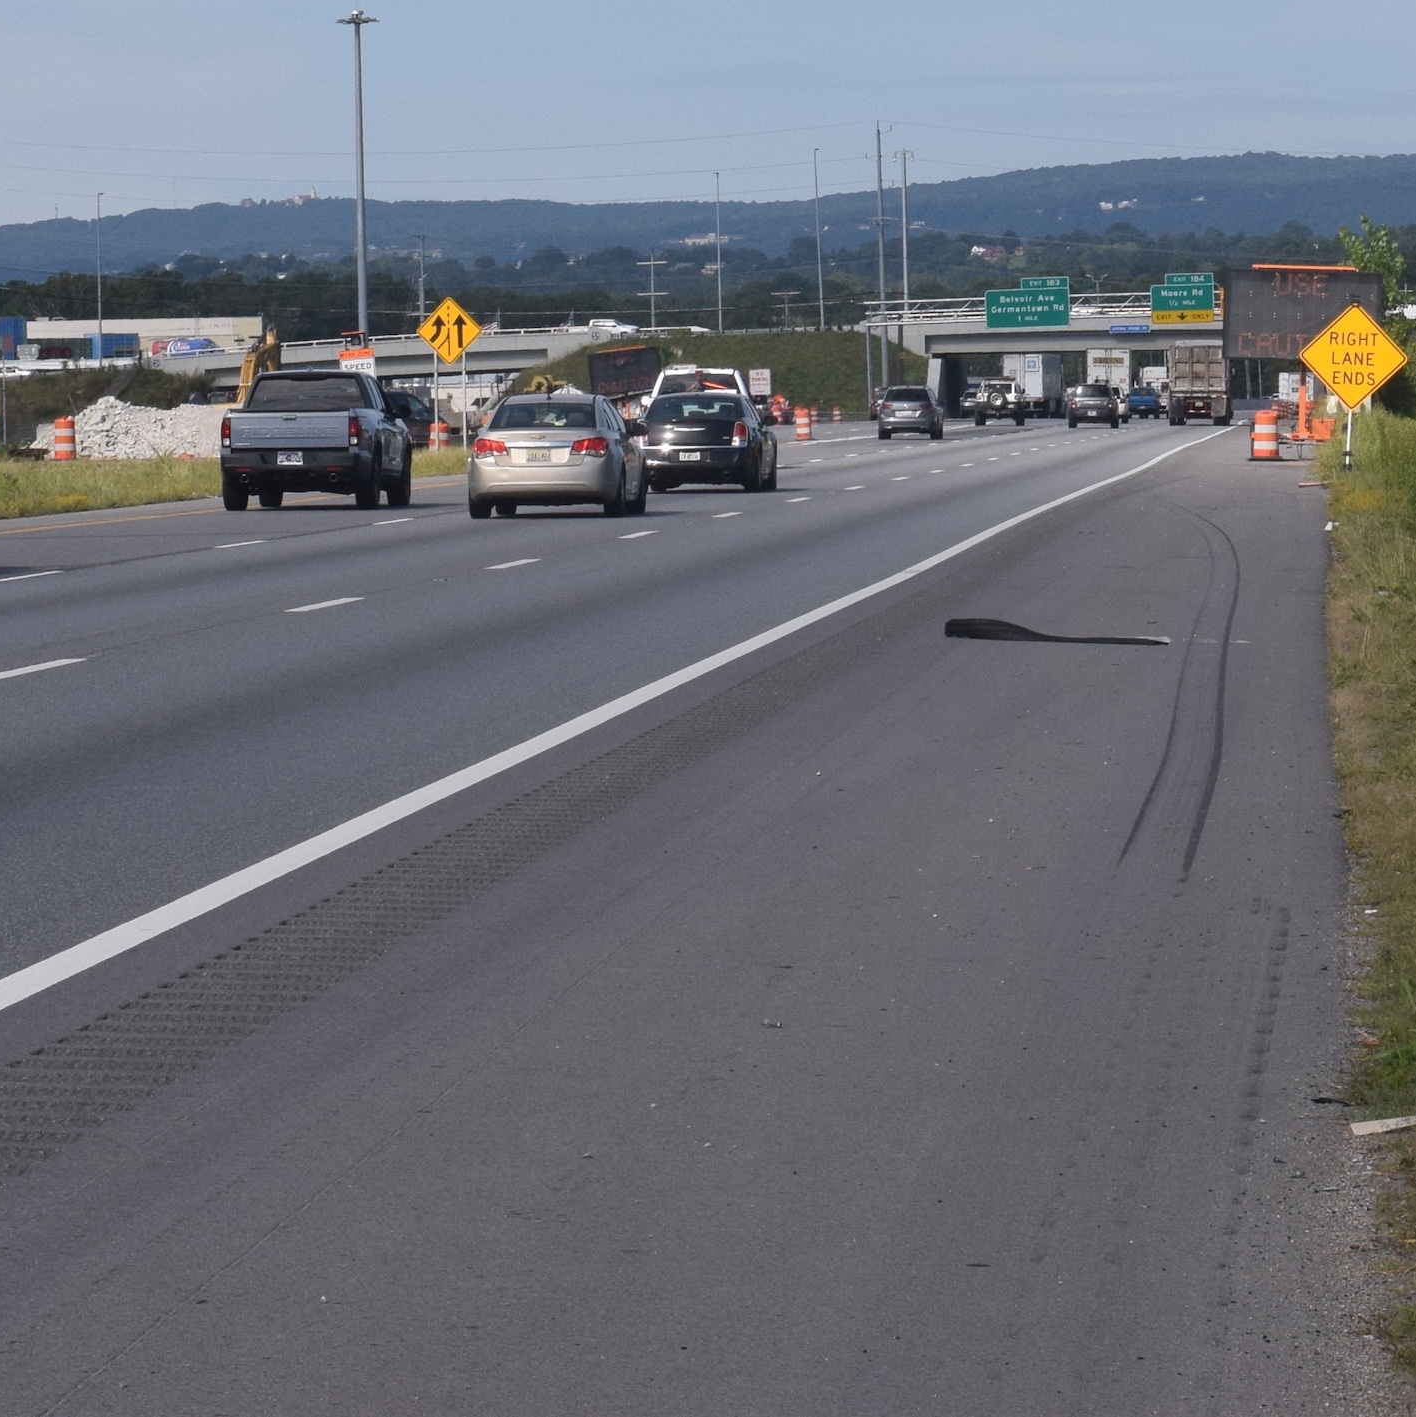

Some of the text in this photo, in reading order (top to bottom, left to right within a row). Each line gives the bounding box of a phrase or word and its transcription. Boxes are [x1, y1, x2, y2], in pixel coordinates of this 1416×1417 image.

[1046, 278, 1060, 287] 183
[1190, 274, 1205, 283] 184
[1276, 273, 1330, 296] USE
[1160, 288, 1204, 298] Moore Rd
[1000, 294, 1055, 304] Belvoir Ave
[991, 303, 1065, 314] Germantown Rd
[1191, 313, 1211, 321] ONLY
[1329, 331, 1379, 347] RIGHT
[1331, 351, 1375, 367] LANE
[344, 362, 372, 371] SPEED
[1332, 371, 1376, 386] ENDS
